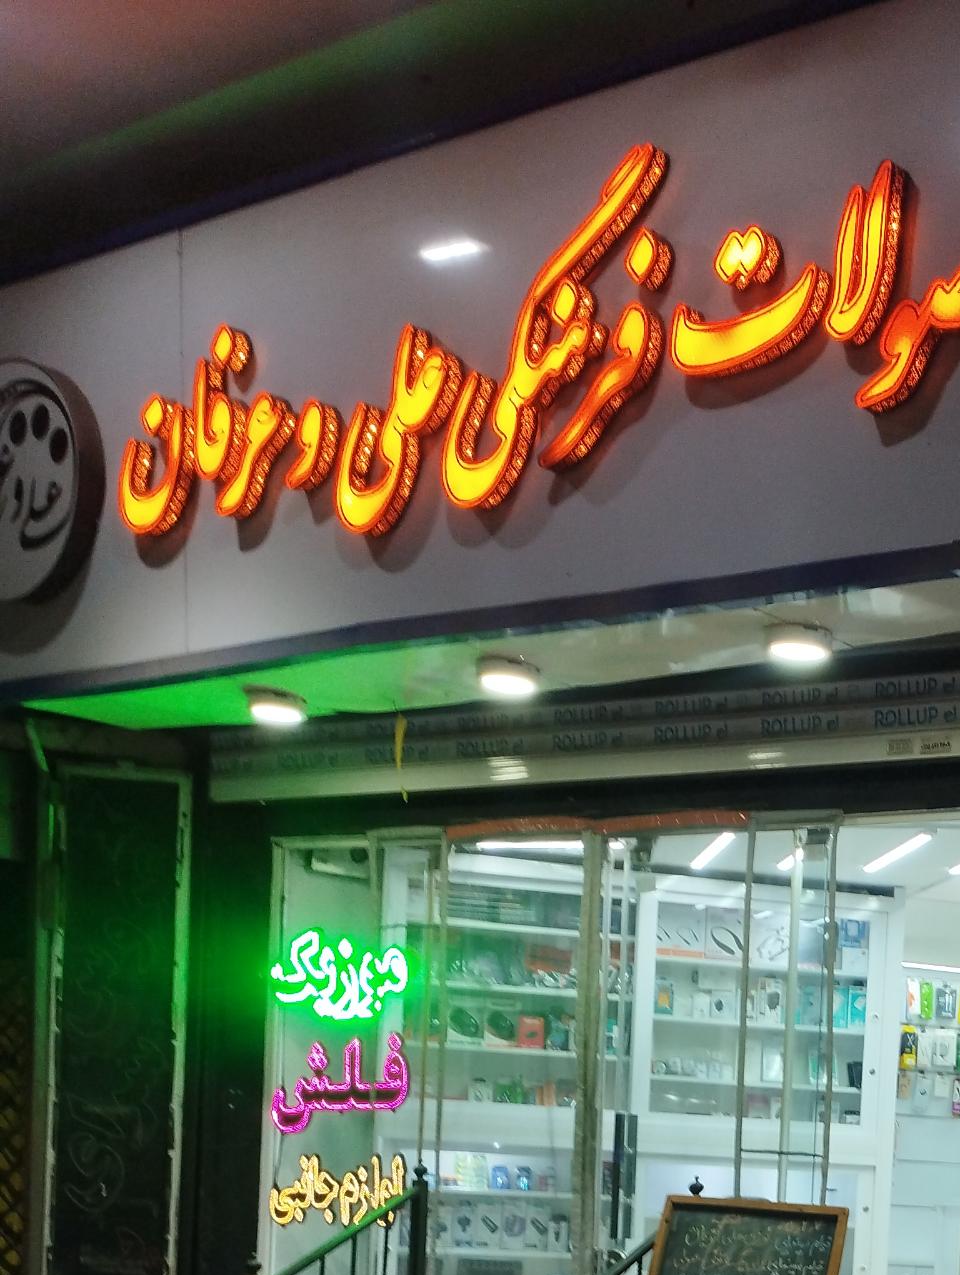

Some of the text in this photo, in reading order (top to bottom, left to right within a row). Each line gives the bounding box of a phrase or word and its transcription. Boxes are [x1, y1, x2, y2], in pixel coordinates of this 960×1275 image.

[440, 143, 675, 510] فرهنگی
[118, 321, 298, 537] عرفان
[285, 398, 342, 491] و
[654, 725, 712, 744] ROLLUP
[761, 714, 821, 738] ROLLUP
[873, 705, 938, 729] ROLLUP
[761, 686, 821, 706] ROLLUP
[875, 676, 938, 698] ROLLUP
[269, 1031, 411, 1135] فلش
[268, 1154, 340, 1226] جانبی
